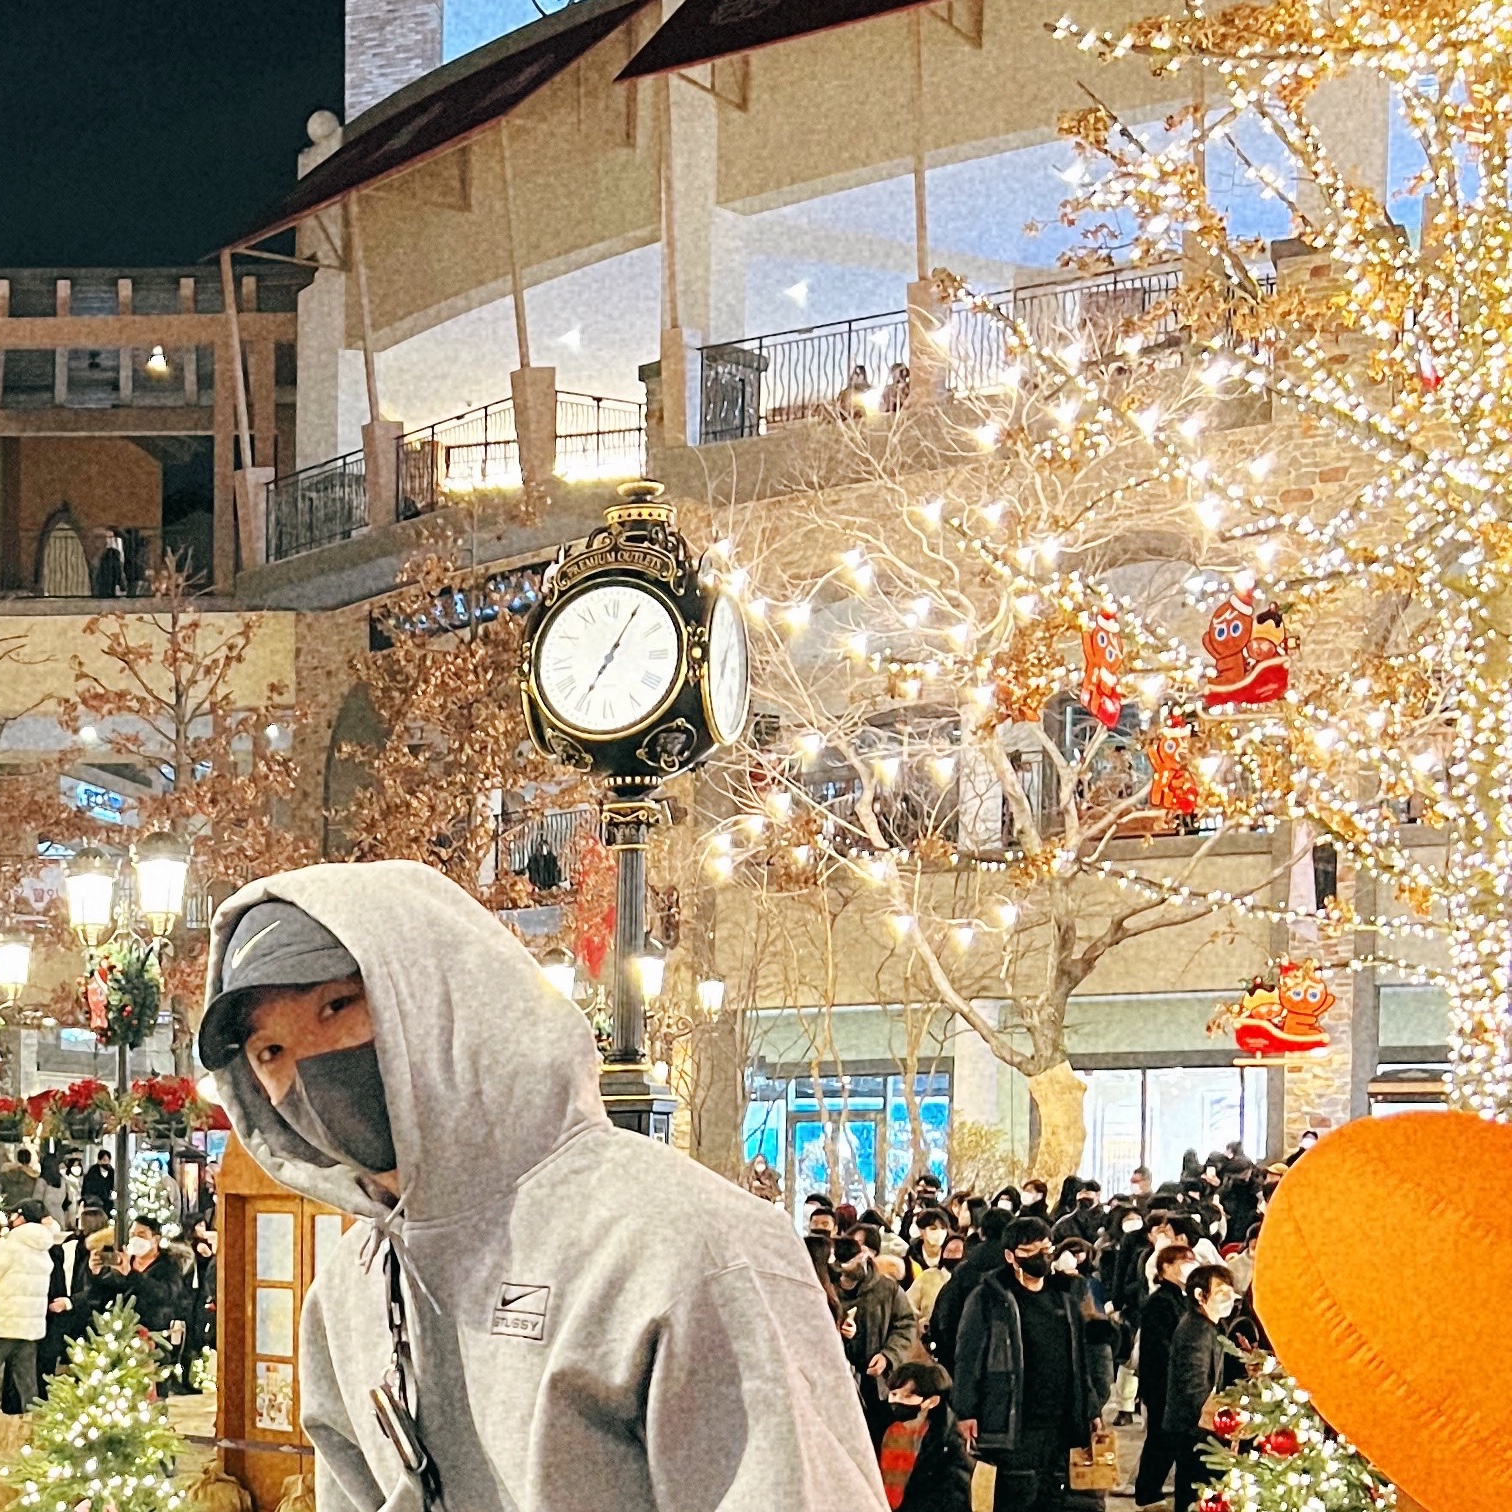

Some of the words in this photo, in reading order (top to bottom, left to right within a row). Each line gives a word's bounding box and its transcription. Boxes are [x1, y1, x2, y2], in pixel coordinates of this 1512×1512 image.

[567, 551, 615, 577] PREMIUM
[617, 551, 661, 570] OUTLETS
[494, 1317, 539, 1332] STUSSY
